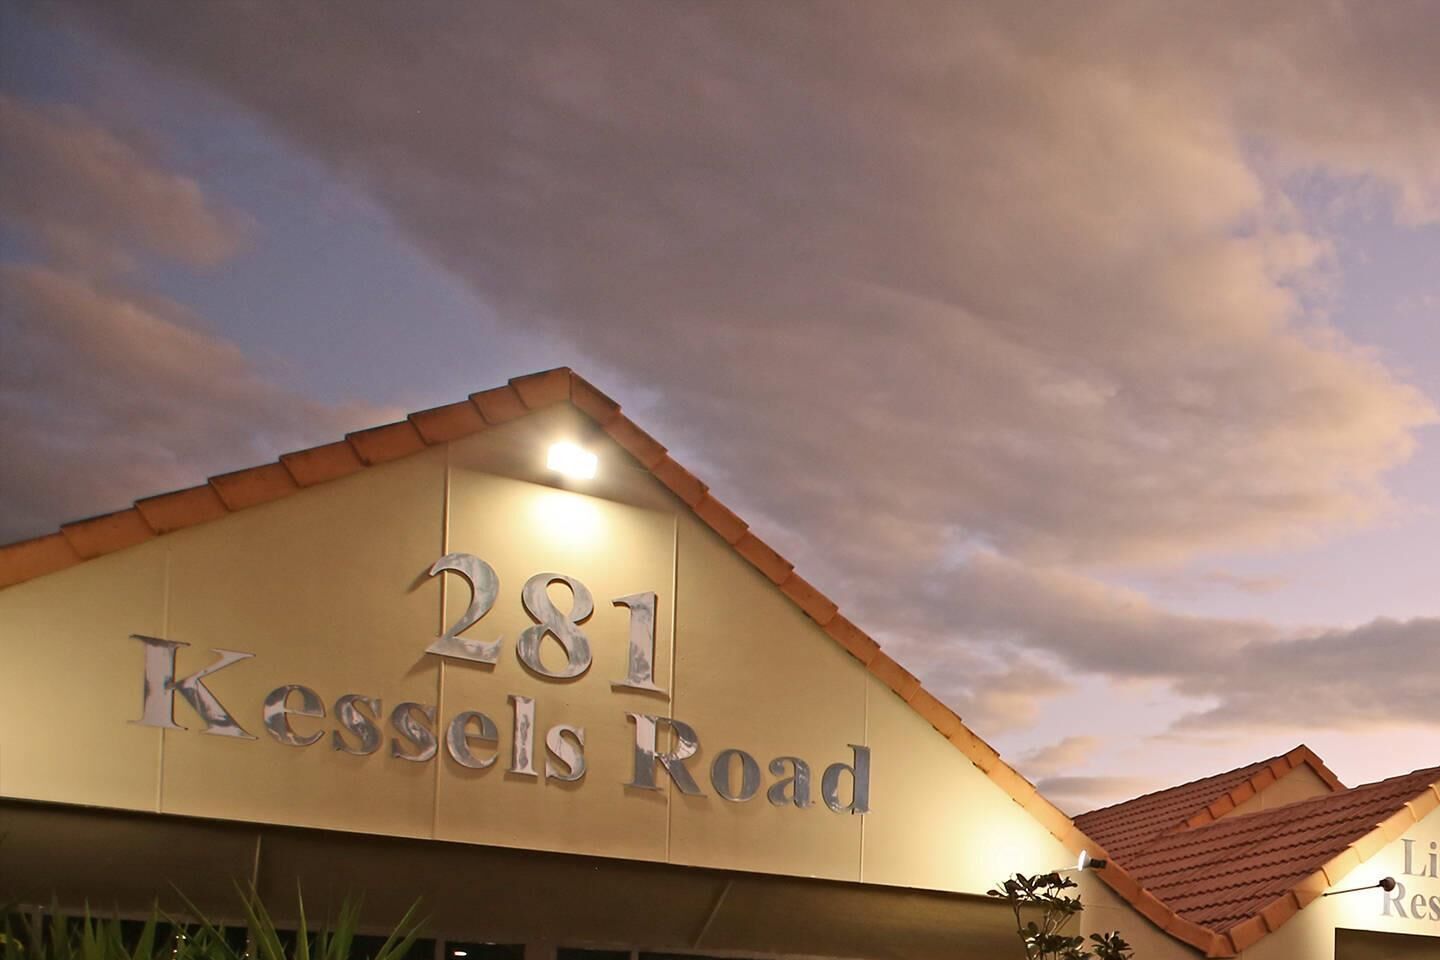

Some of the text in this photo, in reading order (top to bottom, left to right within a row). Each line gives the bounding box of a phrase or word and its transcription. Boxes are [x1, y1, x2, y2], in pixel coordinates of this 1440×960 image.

[425, 551, 670, 700] 281
[126, 632, 874, 816] Kessels Road
